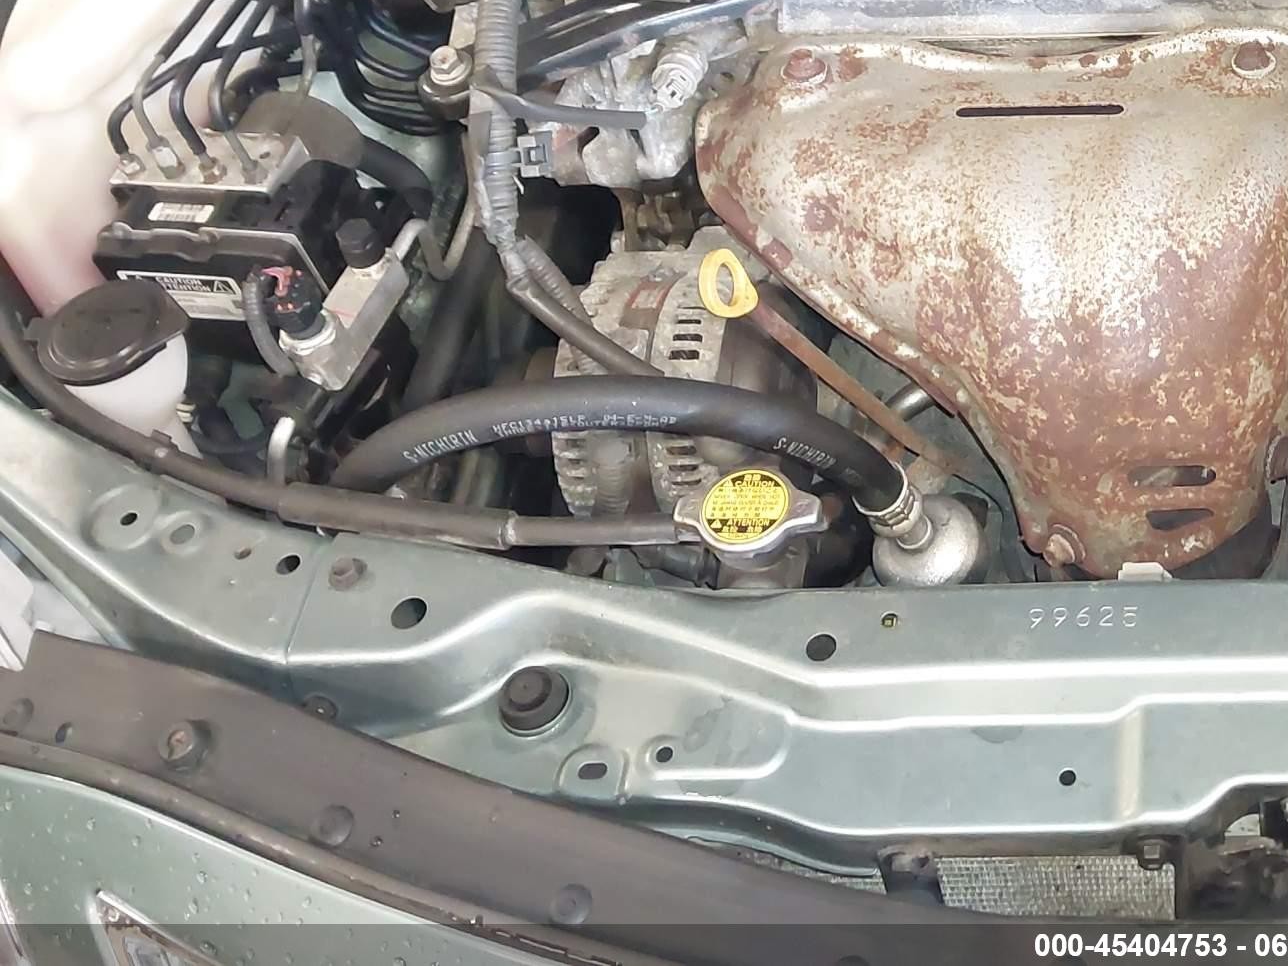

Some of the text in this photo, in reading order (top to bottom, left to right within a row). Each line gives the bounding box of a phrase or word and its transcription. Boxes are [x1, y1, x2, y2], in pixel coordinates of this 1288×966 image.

[155, 276, 203, 286] CAUTION
[161, 283, 212, 292] TTENTION
[727, 518, 770, 526] ATTENTION
